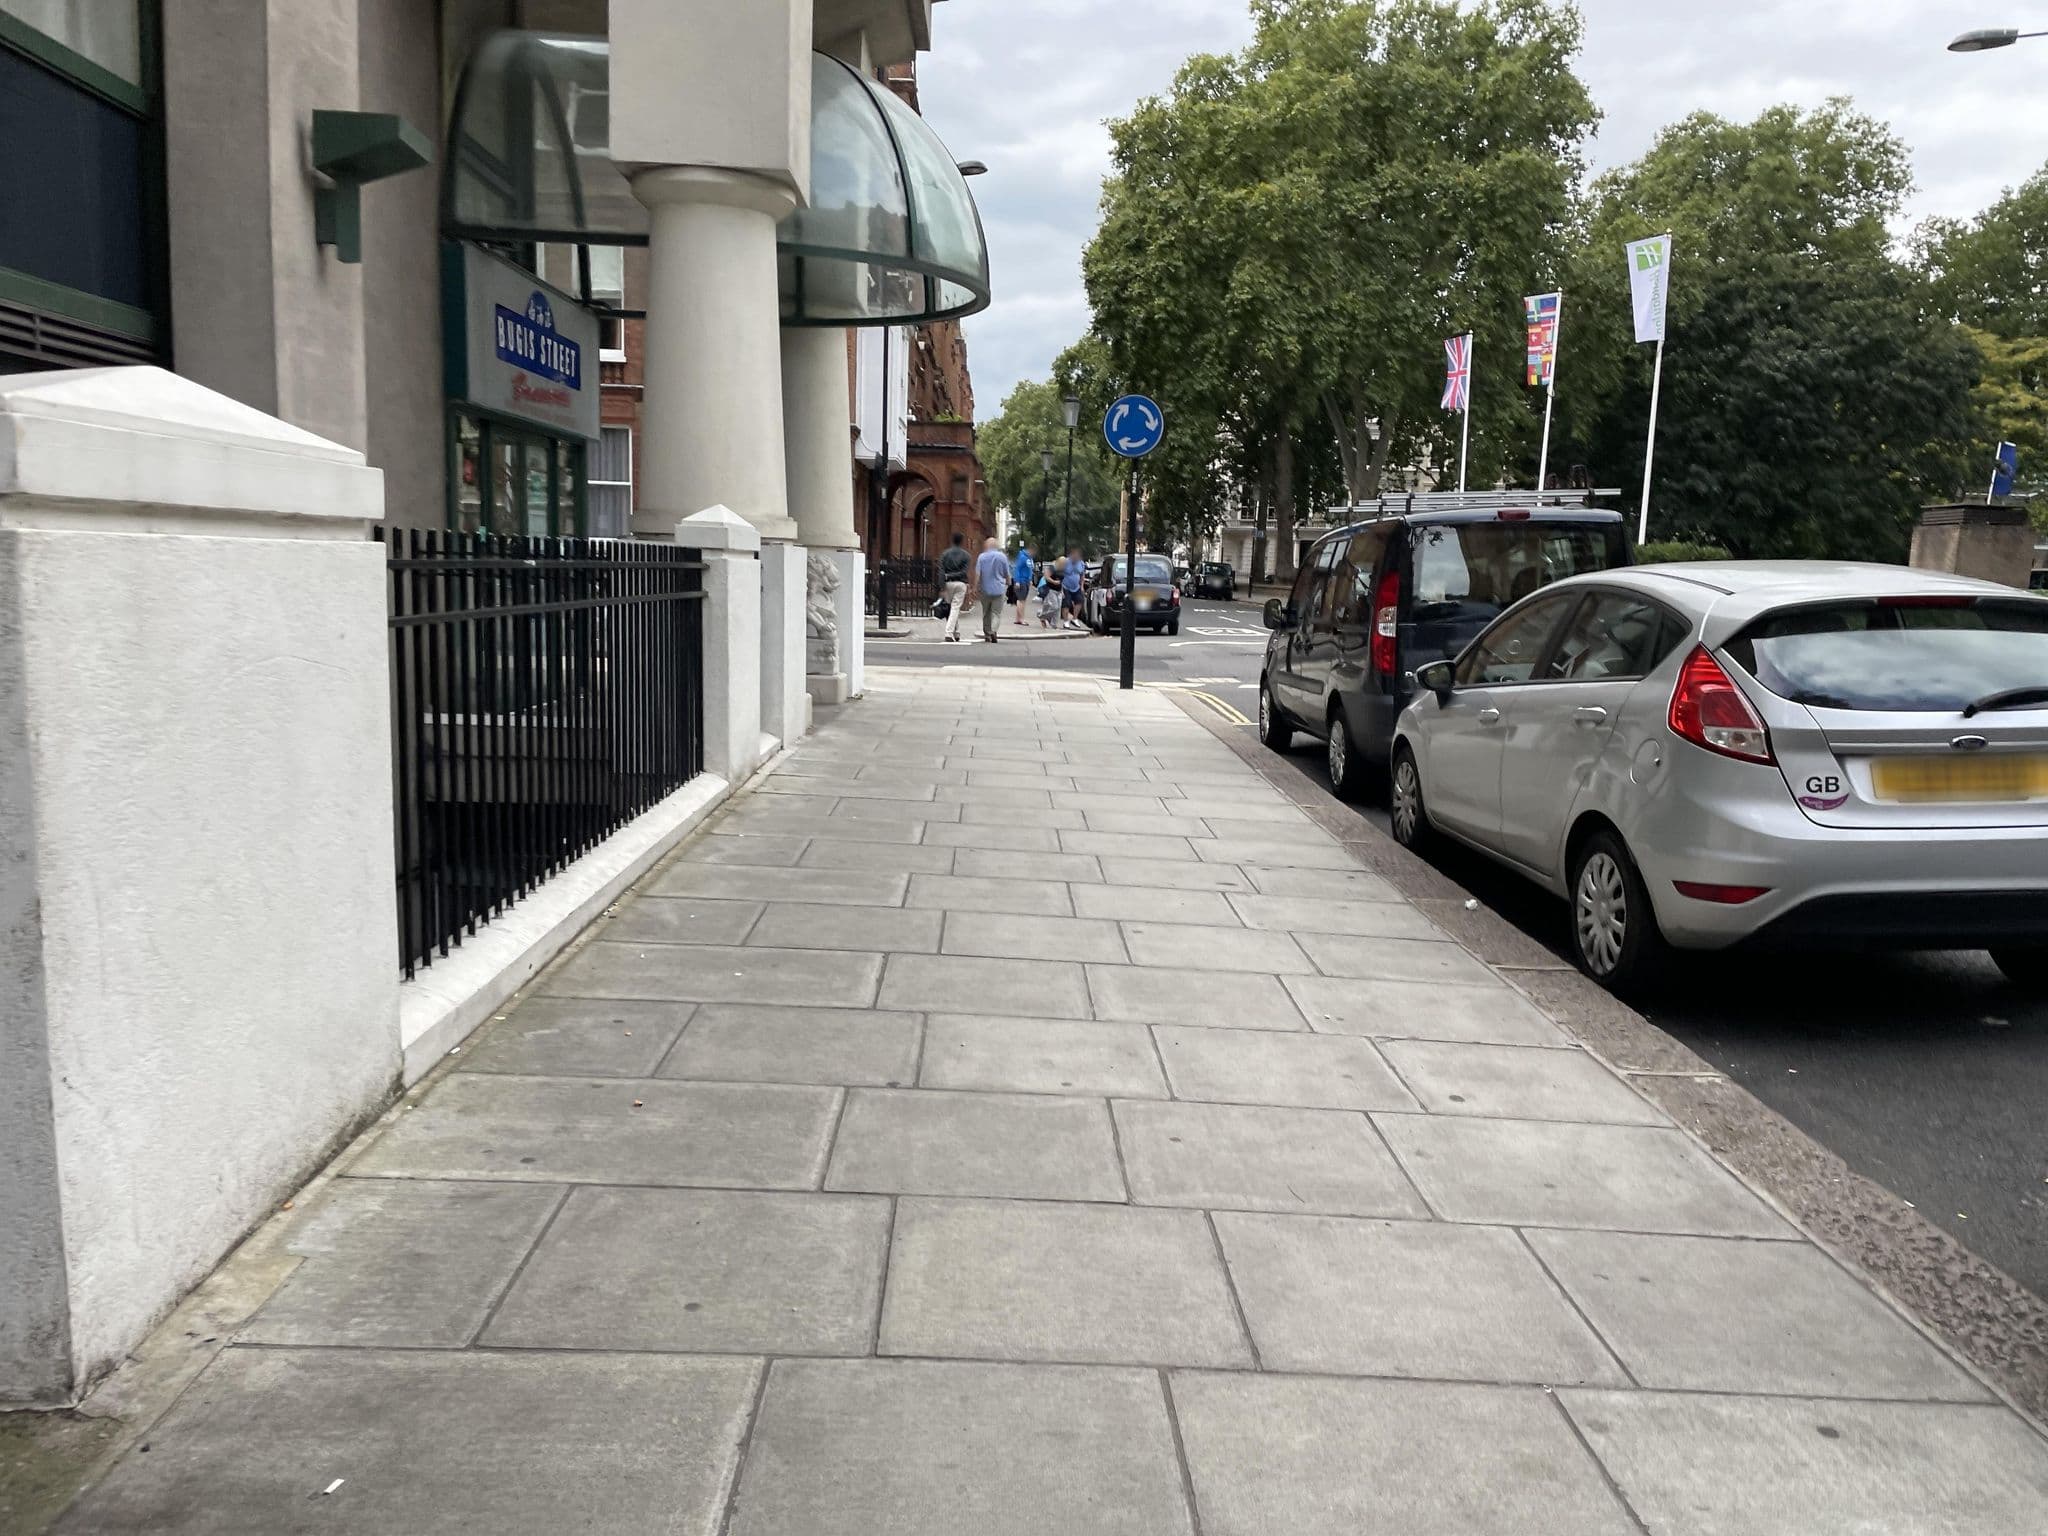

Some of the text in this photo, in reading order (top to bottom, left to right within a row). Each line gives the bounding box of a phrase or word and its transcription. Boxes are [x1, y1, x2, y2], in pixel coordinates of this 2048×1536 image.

[497, 315, 576, 377] BUGIS STREET
[1806, 776, 1840, 793] GB
